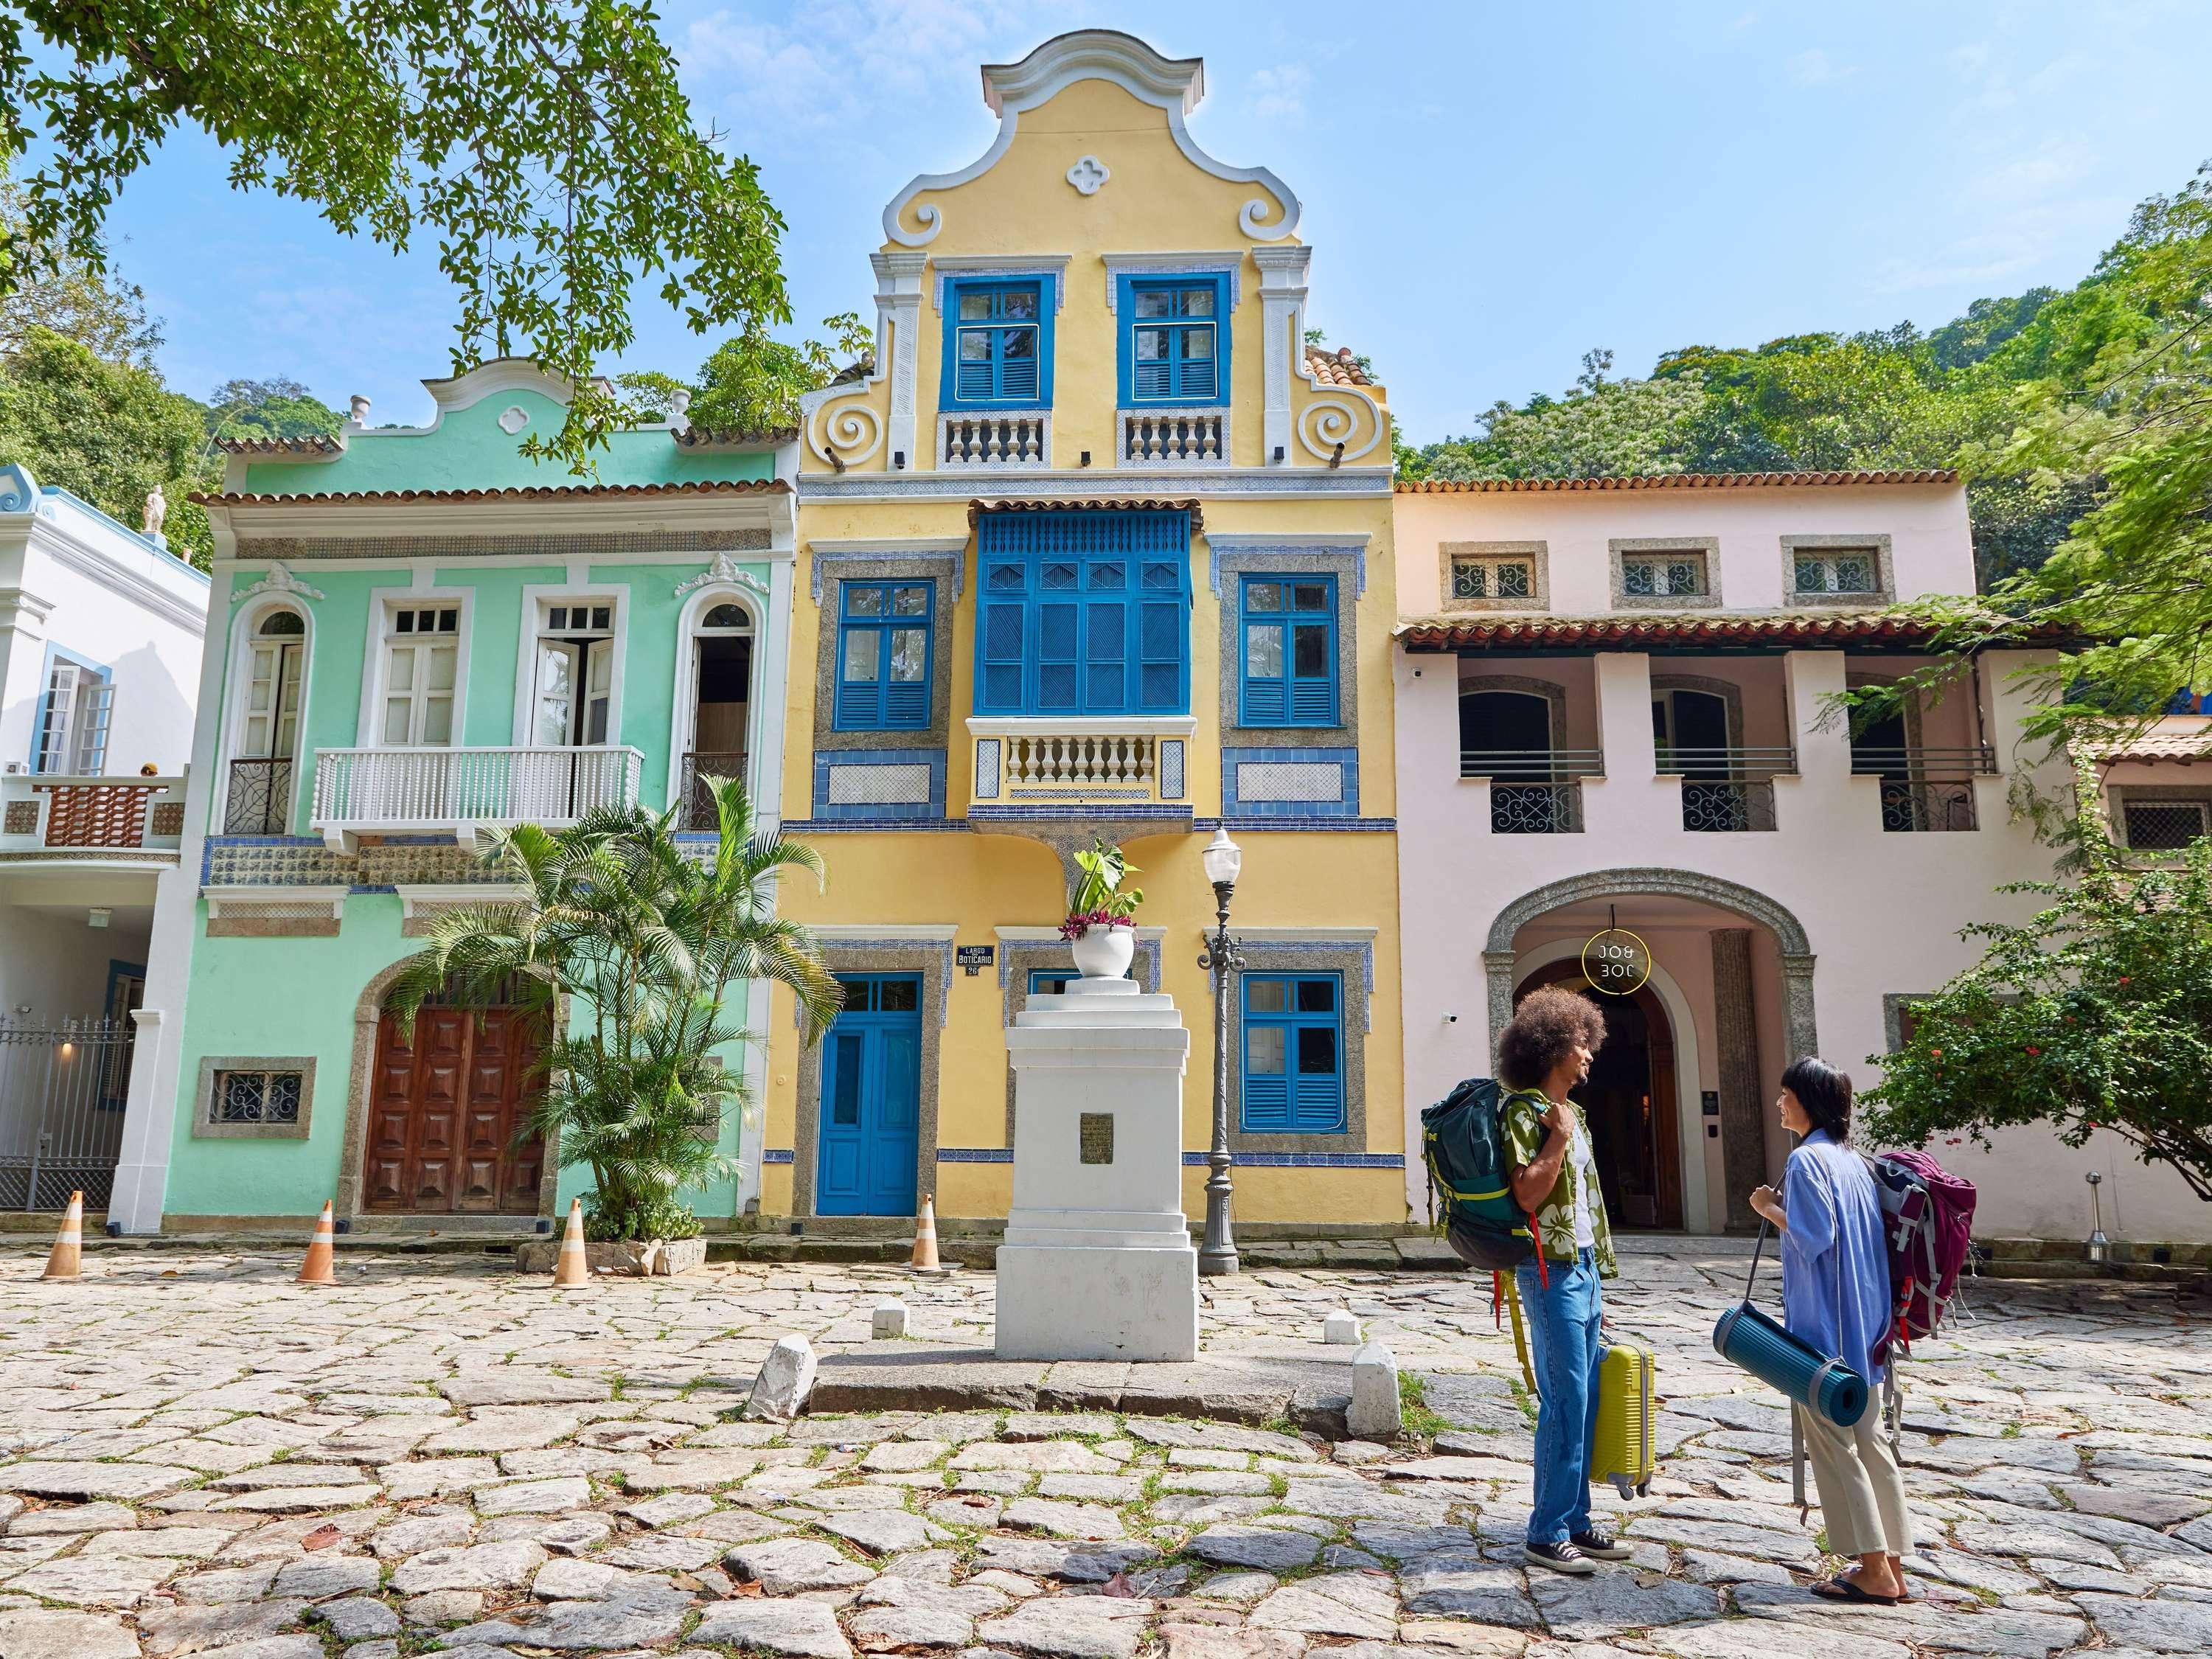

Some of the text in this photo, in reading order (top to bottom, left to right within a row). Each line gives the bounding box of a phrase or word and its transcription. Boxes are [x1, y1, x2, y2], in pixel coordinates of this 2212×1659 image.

[959, 956, 992, 964] BOTICARIO
[968, 967, 977, 975] 26
[1601, 964, 1635, 977] JOE
